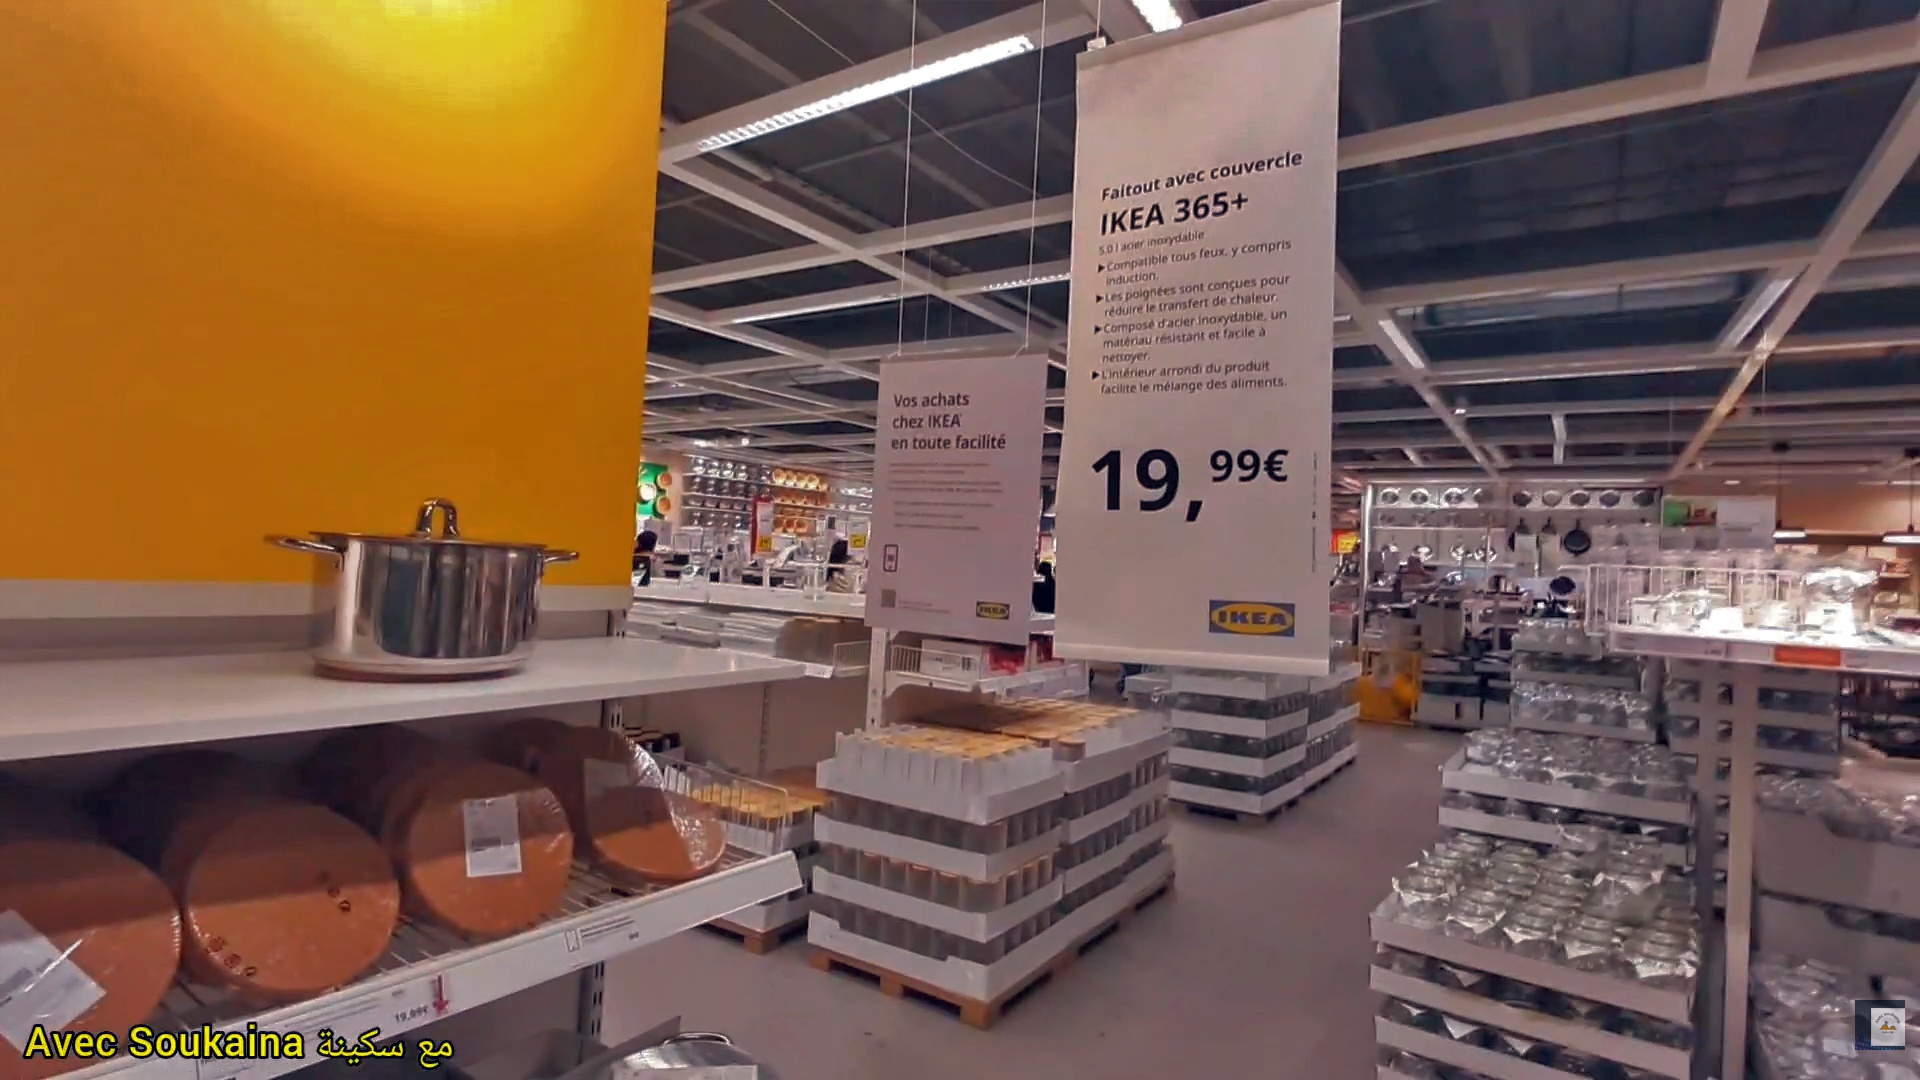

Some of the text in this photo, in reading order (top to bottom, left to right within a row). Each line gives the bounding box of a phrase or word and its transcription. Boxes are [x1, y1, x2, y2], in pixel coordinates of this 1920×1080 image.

[1101, 151, 1303, 201] Faitout avec couvercle
[1100, 191, 1249, 236] IKEA 365+
[1147, 231, 1204, 250] inoxydable
[1107, 239, 1291, 273] Compatible tous feux, y compris
[1106, 271, 1159, 286] induction.
[1105, 275, 1290, 303] Les poignées sont conçues pour
[1104, 292, 1279, 317] réduire le transfert de chaleur.
[1103, 309, 1287, 334] Composé d'acier inoxydable, un
[1103, 327, 1266, 349] matériau résistant et facile à
[1102, 352, 1151, 366] nettoyer.
[1101, 360, 1270, 380] L'intérieur arrondi du produit
[1100, 376, 1287, 395] facilite le mélange des aliments.
[893, 392, 970, 408] Vos achats
[893, 415, 924, 429] chez
[891, 433, 1006, 449] en toute facilité
[1217, 611, 1287, 626] IKEA
